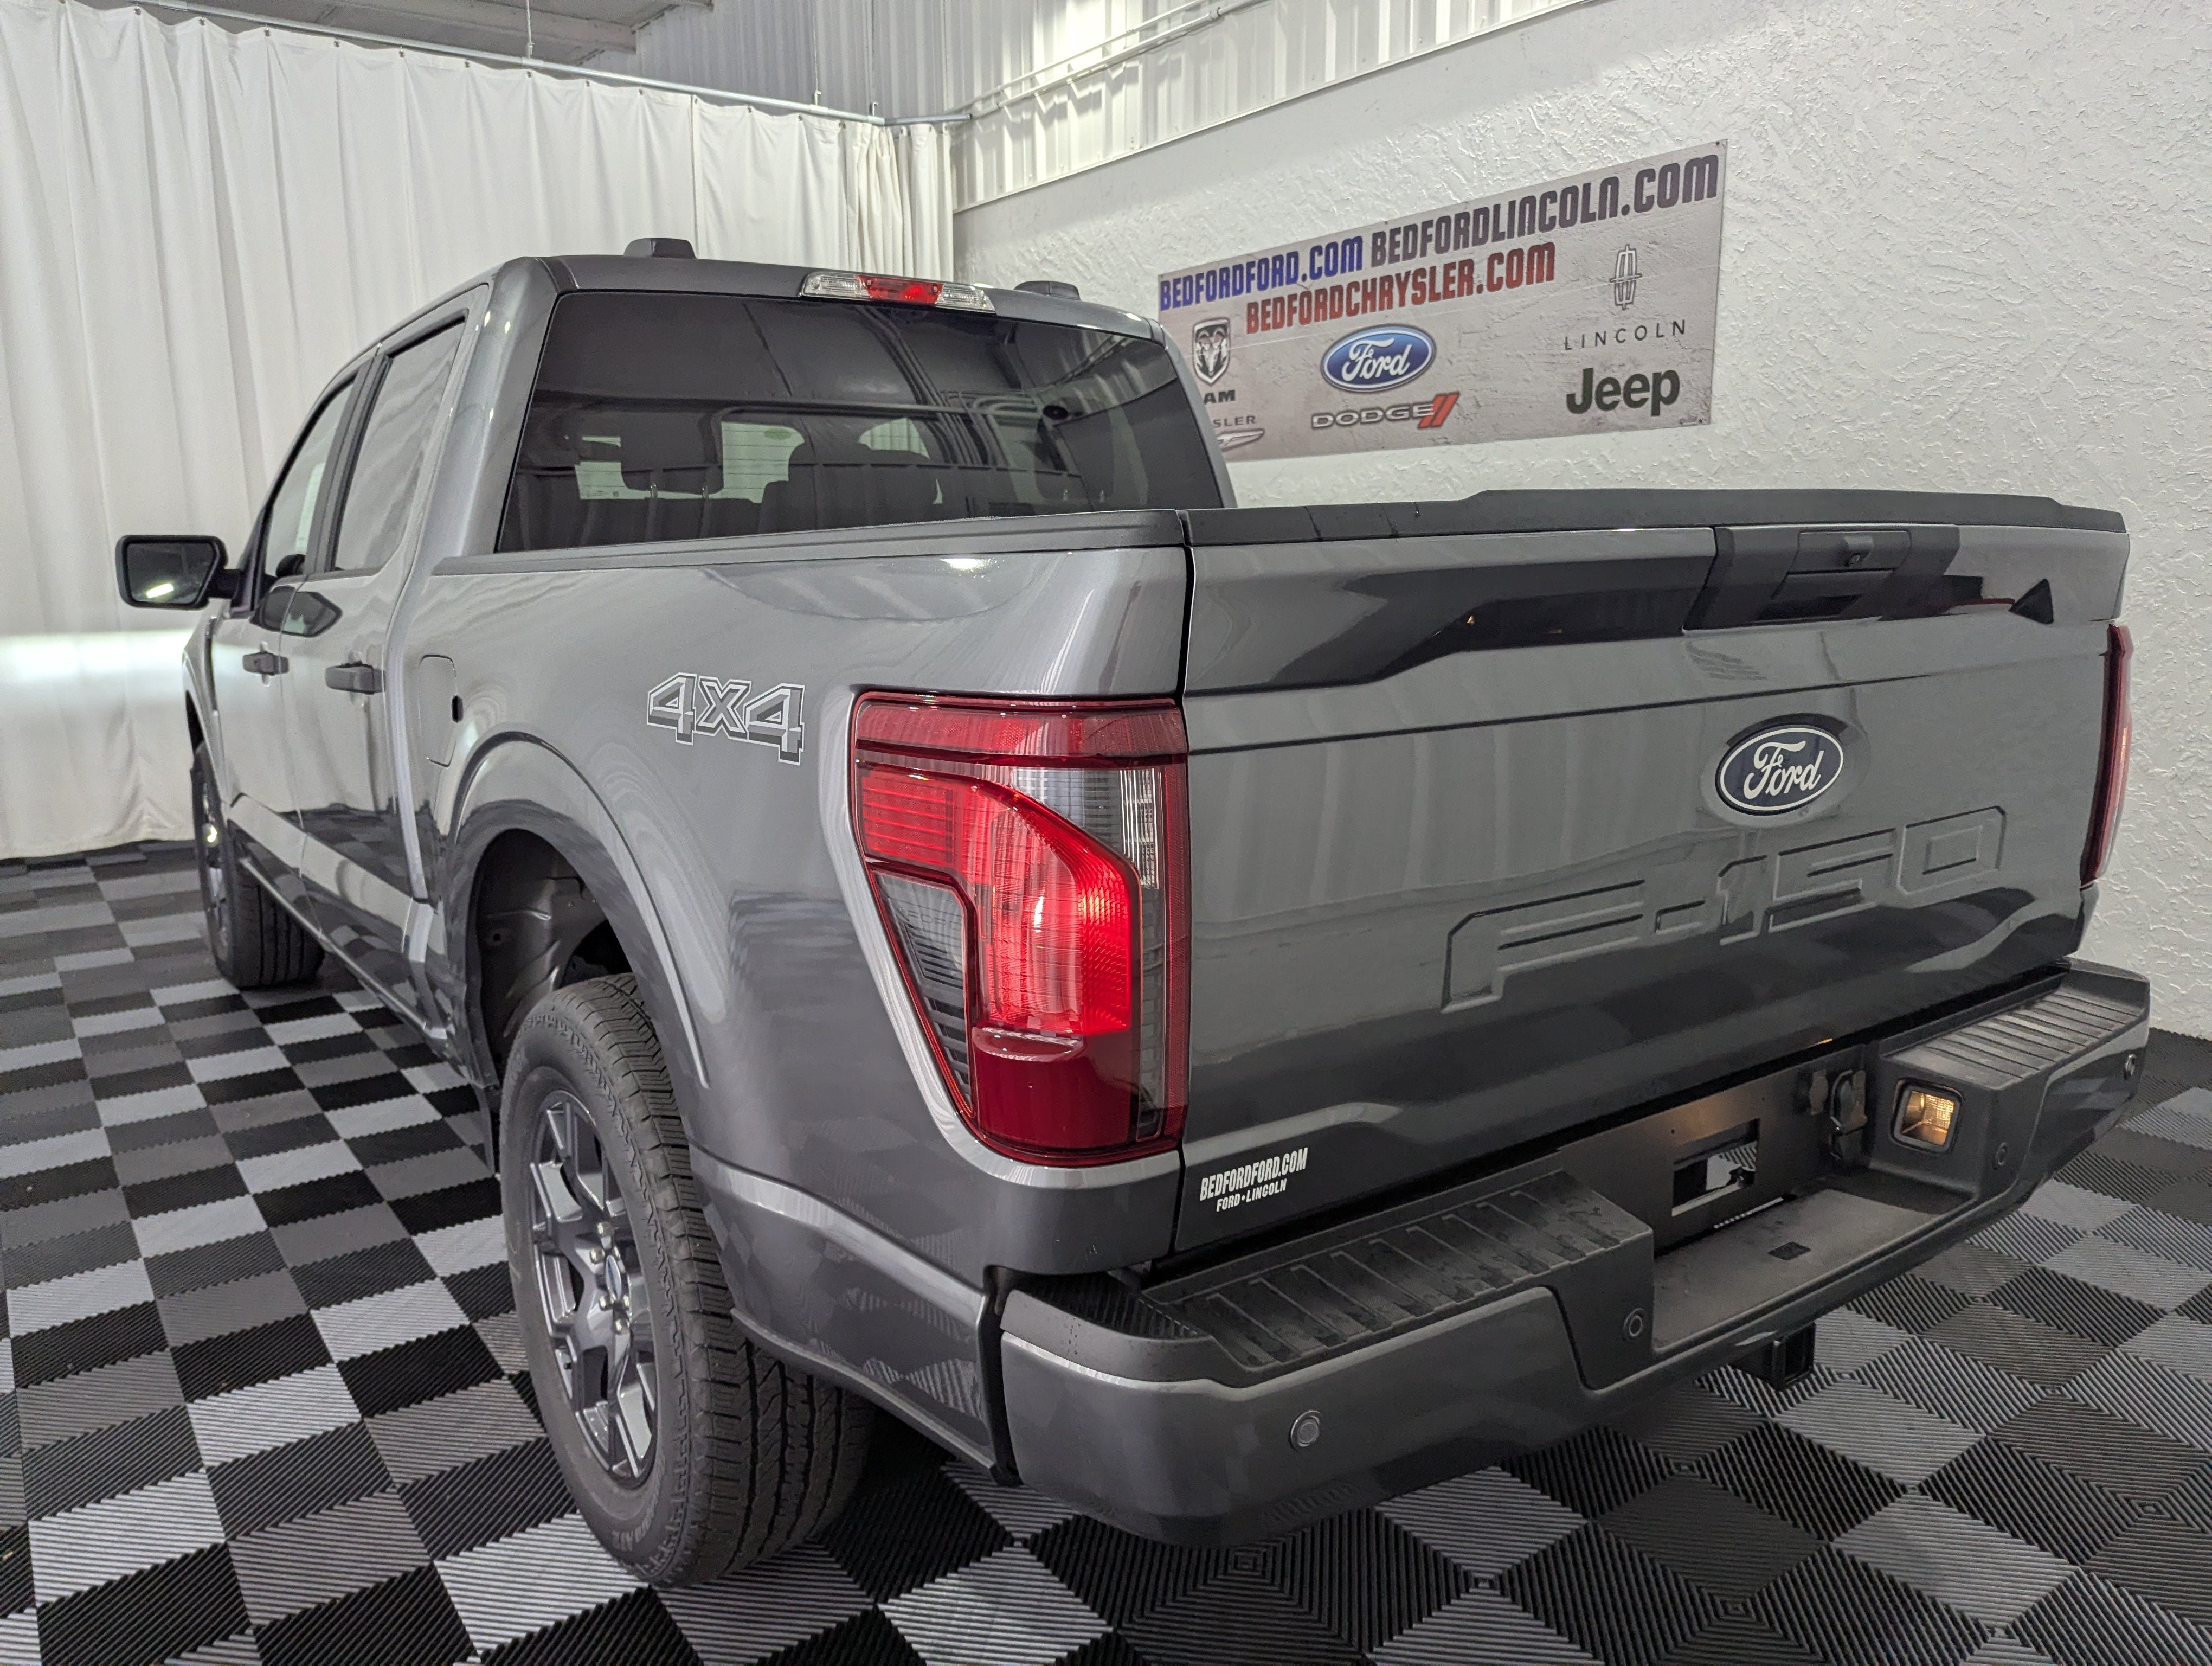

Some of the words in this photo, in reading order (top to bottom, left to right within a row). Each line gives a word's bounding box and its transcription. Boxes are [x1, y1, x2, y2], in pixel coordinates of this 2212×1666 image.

[1160, 236, 1363, 311] BEDFORDFORD.COM
[1371, 154, 1720, 268] BEDFORDLINCOLN.COM
[1246, 241, 1556, 335] BEDFORDCHRYSLER.COM
[1342, 337, 1412, 381] Ford
[1564, 319, 1687, 351] LINCOLN
[1203, 389, 1236, 405] AM
[1311, 402, 1437, 429] DODGE
[1565, 367, 1680, 417] Jeep
[1212, 415, 1257, 428] SLER
[1743, 740, 1825, 799] Ford
[1440, 805, 2007, 1014] F-150
[1199, 1147, 1309, 1201] BEDFORDFORD.COM
